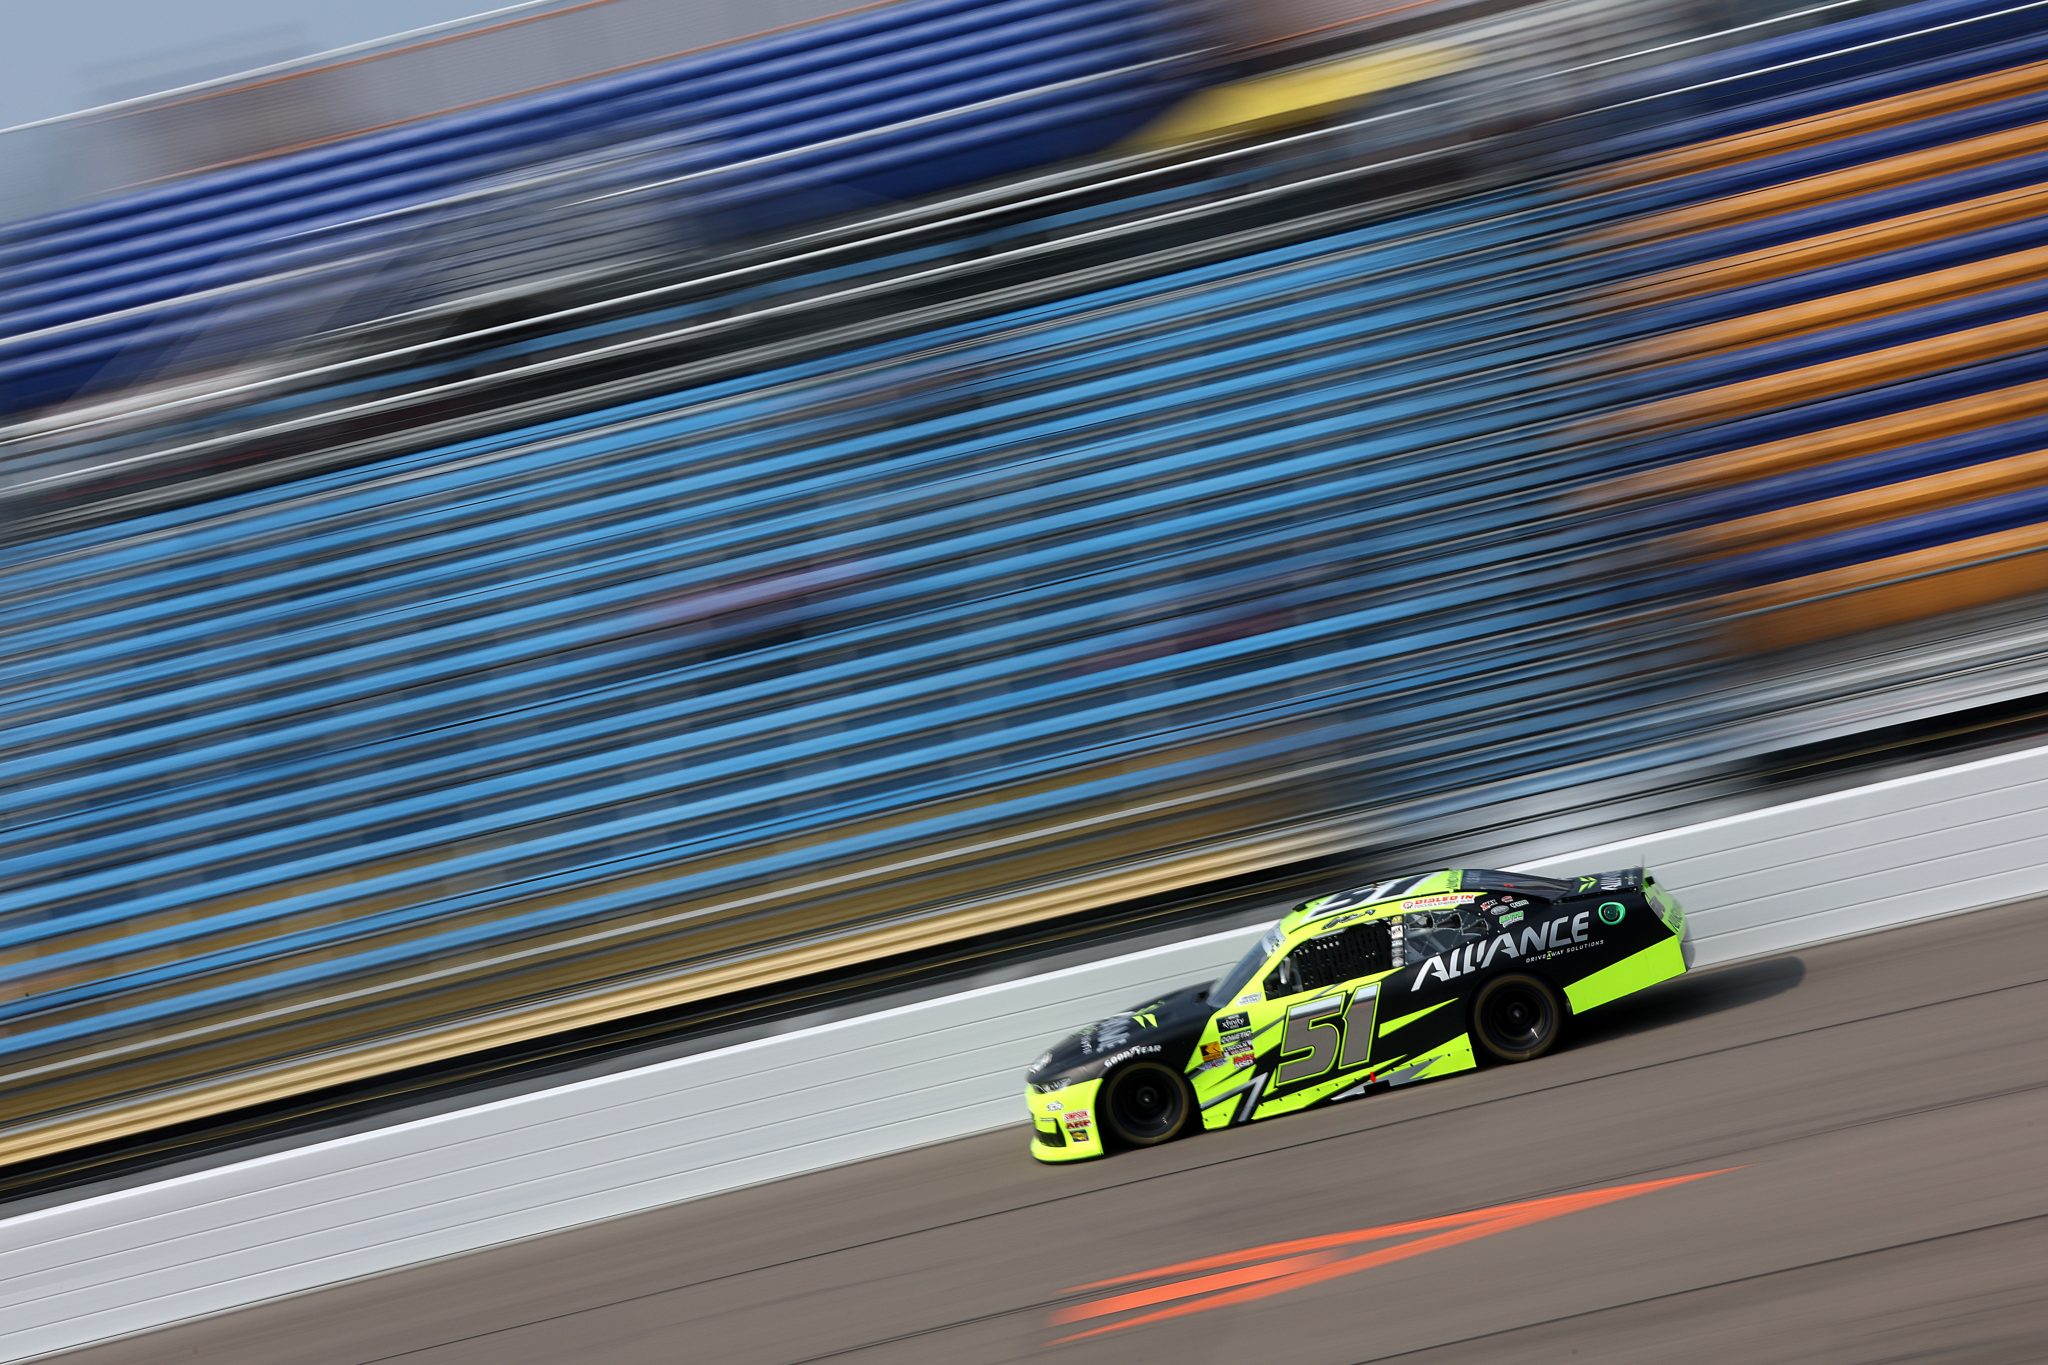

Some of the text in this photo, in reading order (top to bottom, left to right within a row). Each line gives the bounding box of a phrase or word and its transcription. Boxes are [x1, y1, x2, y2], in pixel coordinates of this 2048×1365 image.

[1411, 911, 1589, 992] ALLIANCE
[1525, 939, 1604, 963] DRIVEAWAY SOLUTIONS
[1104, 1045, 1161, 1068] GOODYEAR
[1275, 981, 1382, 1087] 51
